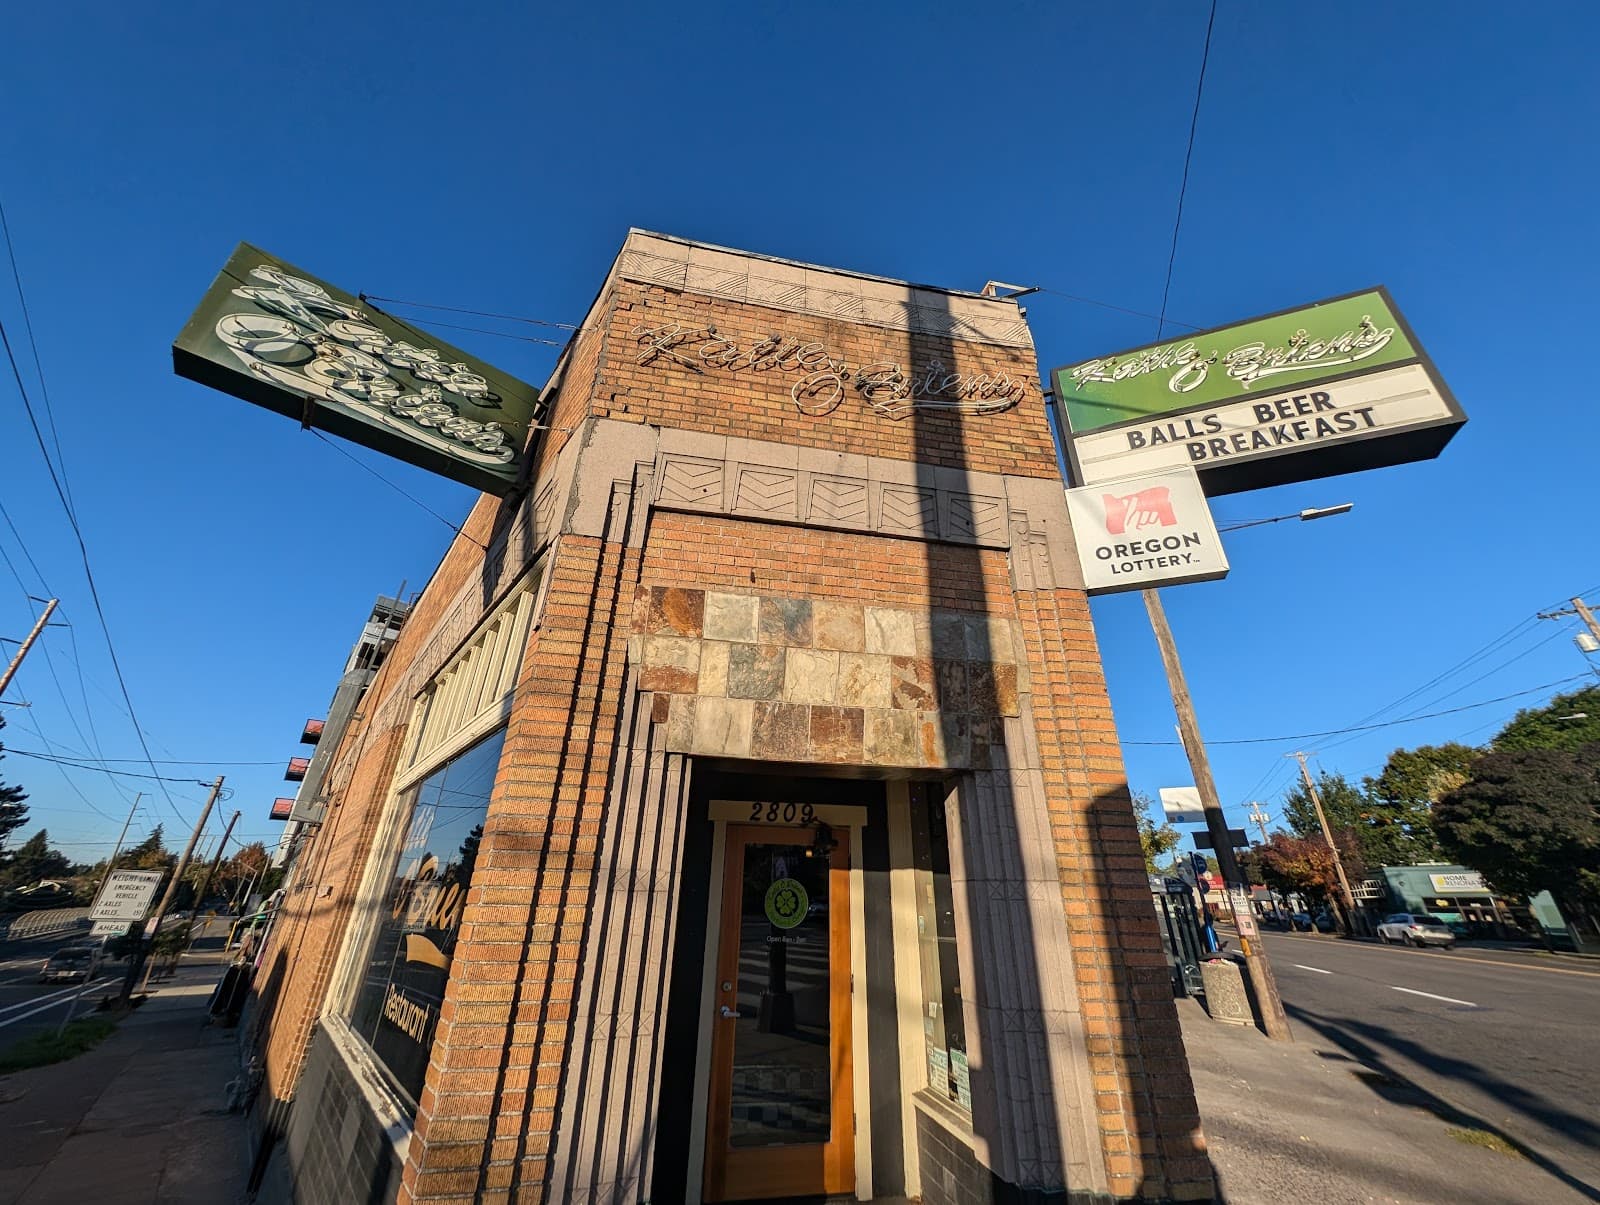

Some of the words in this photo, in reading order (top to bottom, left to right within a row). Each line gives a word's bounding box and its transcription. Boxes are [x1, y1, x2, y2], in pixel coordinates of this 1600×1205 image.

[631, 322, 829, 366] Katie
[1069, 342, 1200, 392] Katie
[1126, 413, 1222, 451] BALLS
[1252, 391, 1337, 424] BEER
[1186, 406, 1378, 462] BREAKFAST
[1095, 532, 1201, 561] OREGON
[1110, 552, 1192, 575] LOTTERY
[749, 801, 814, 823] 2809
[384, 983, 431, 1044] Restaurant
